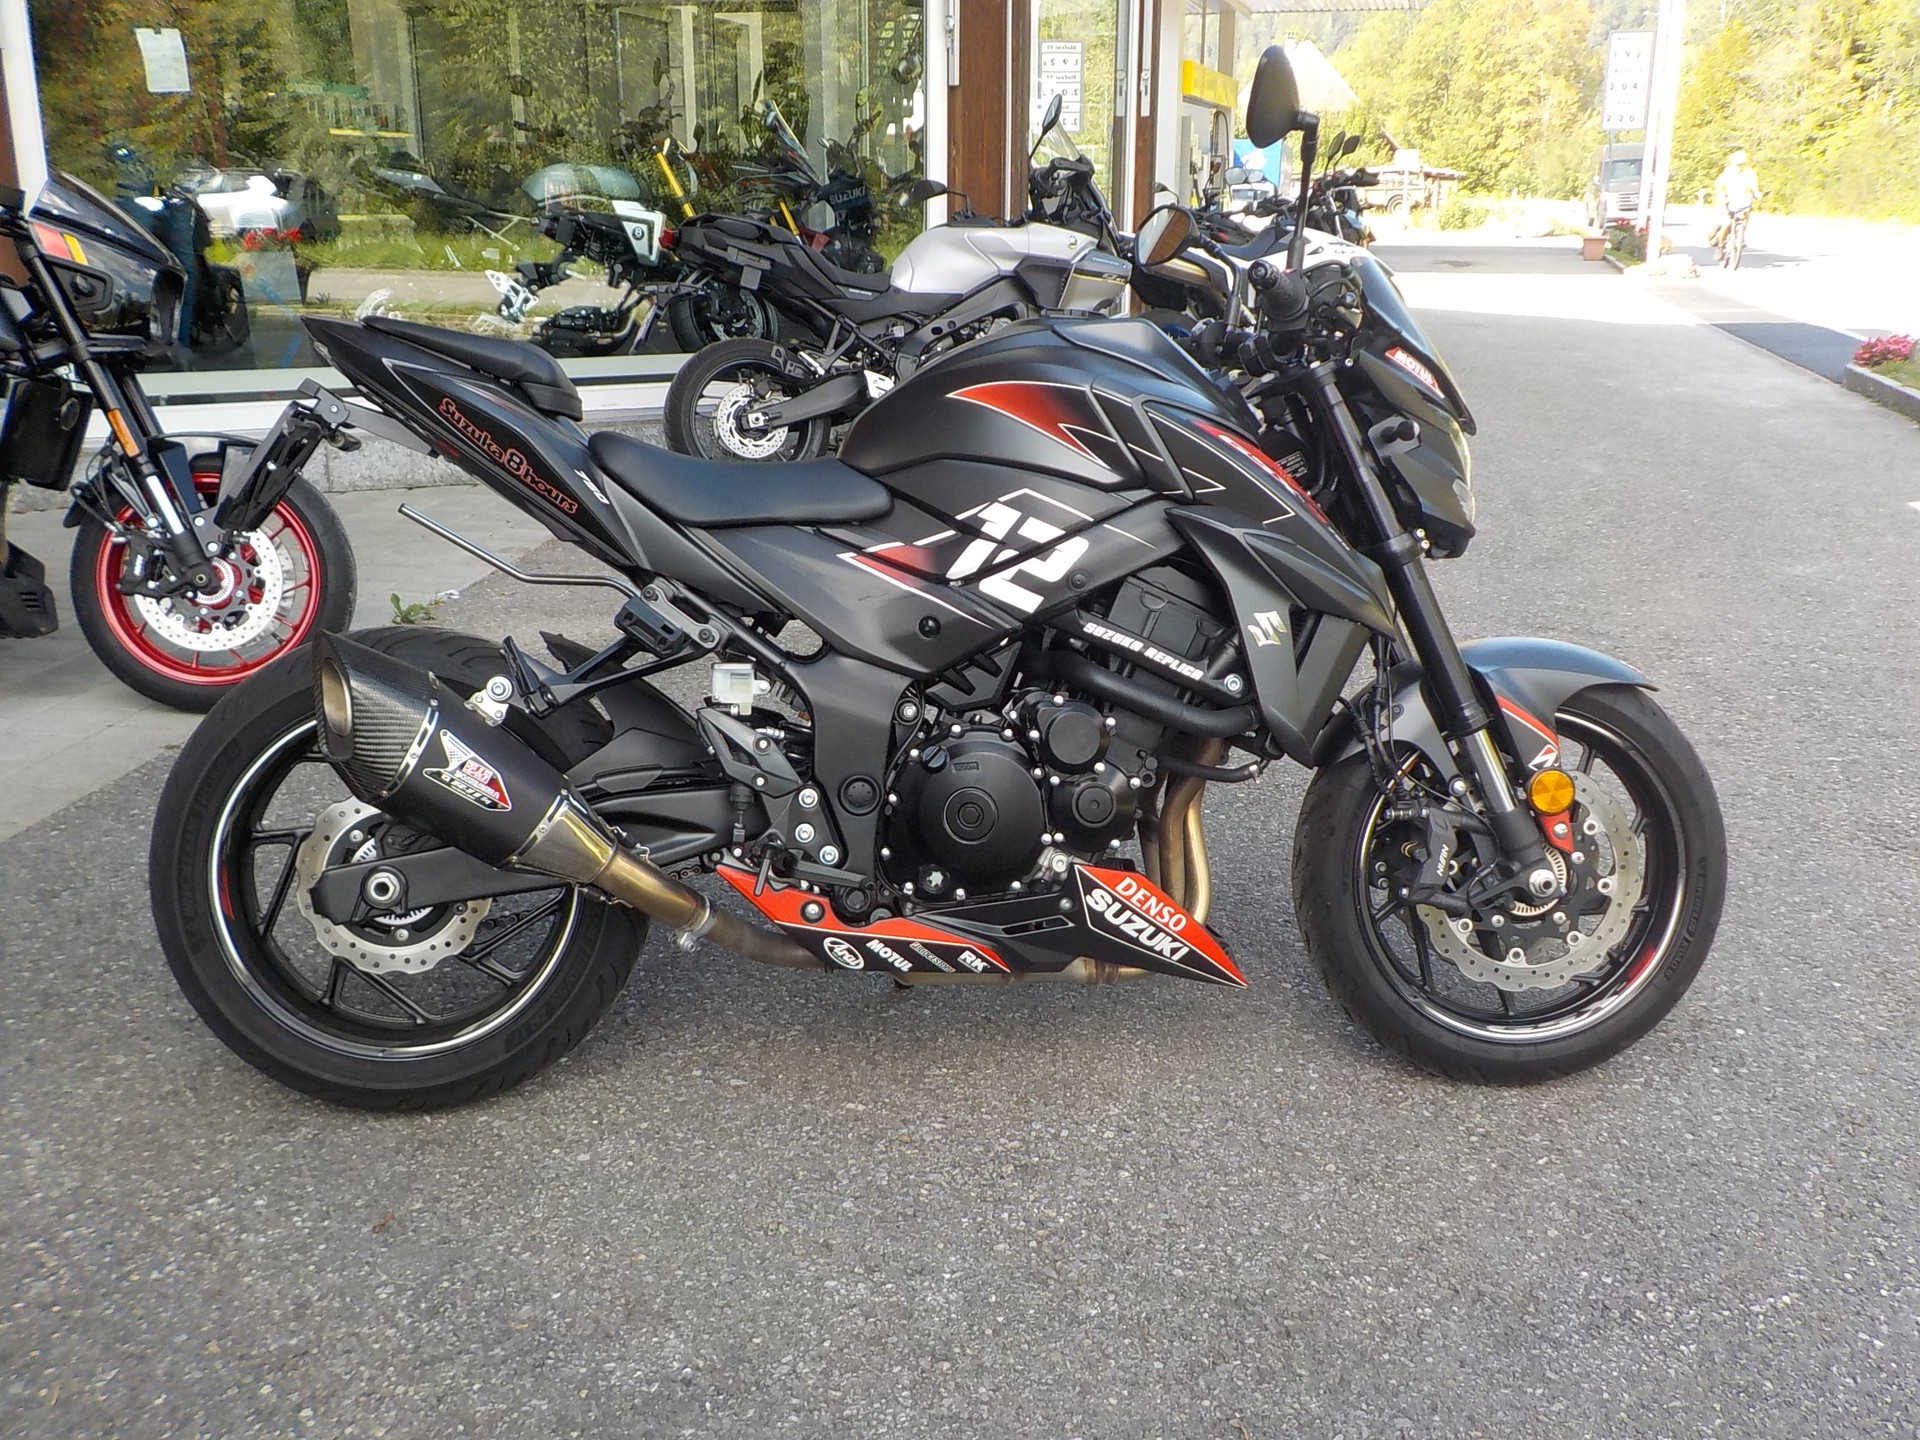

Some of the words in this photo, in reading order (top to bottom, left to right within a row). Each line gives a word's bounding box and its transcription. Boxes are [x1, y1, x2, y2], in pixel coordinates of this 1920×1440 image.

[829, 185, 867, 205] SUZUKI
[1393, 349, 1434, 385] MOTUL
[439, 398, 504, 463] Suzuka
[503, 448, 527, 475] 8
[522, 465, 579, 514] hours
[574, 468, 611, 505] 750
[1083, 621, 1144, 652] SUZUKA
[1143, 646, 1204, 681] REPLICA
[1115, 876, 1187, 932] DENSO
[1085, 888, 1190, 961] SUZUKI
[826, 938, 862, 968] Arai
[865, 939, 914, 972] MOTUL
[958, 949, 989, 972] RK
